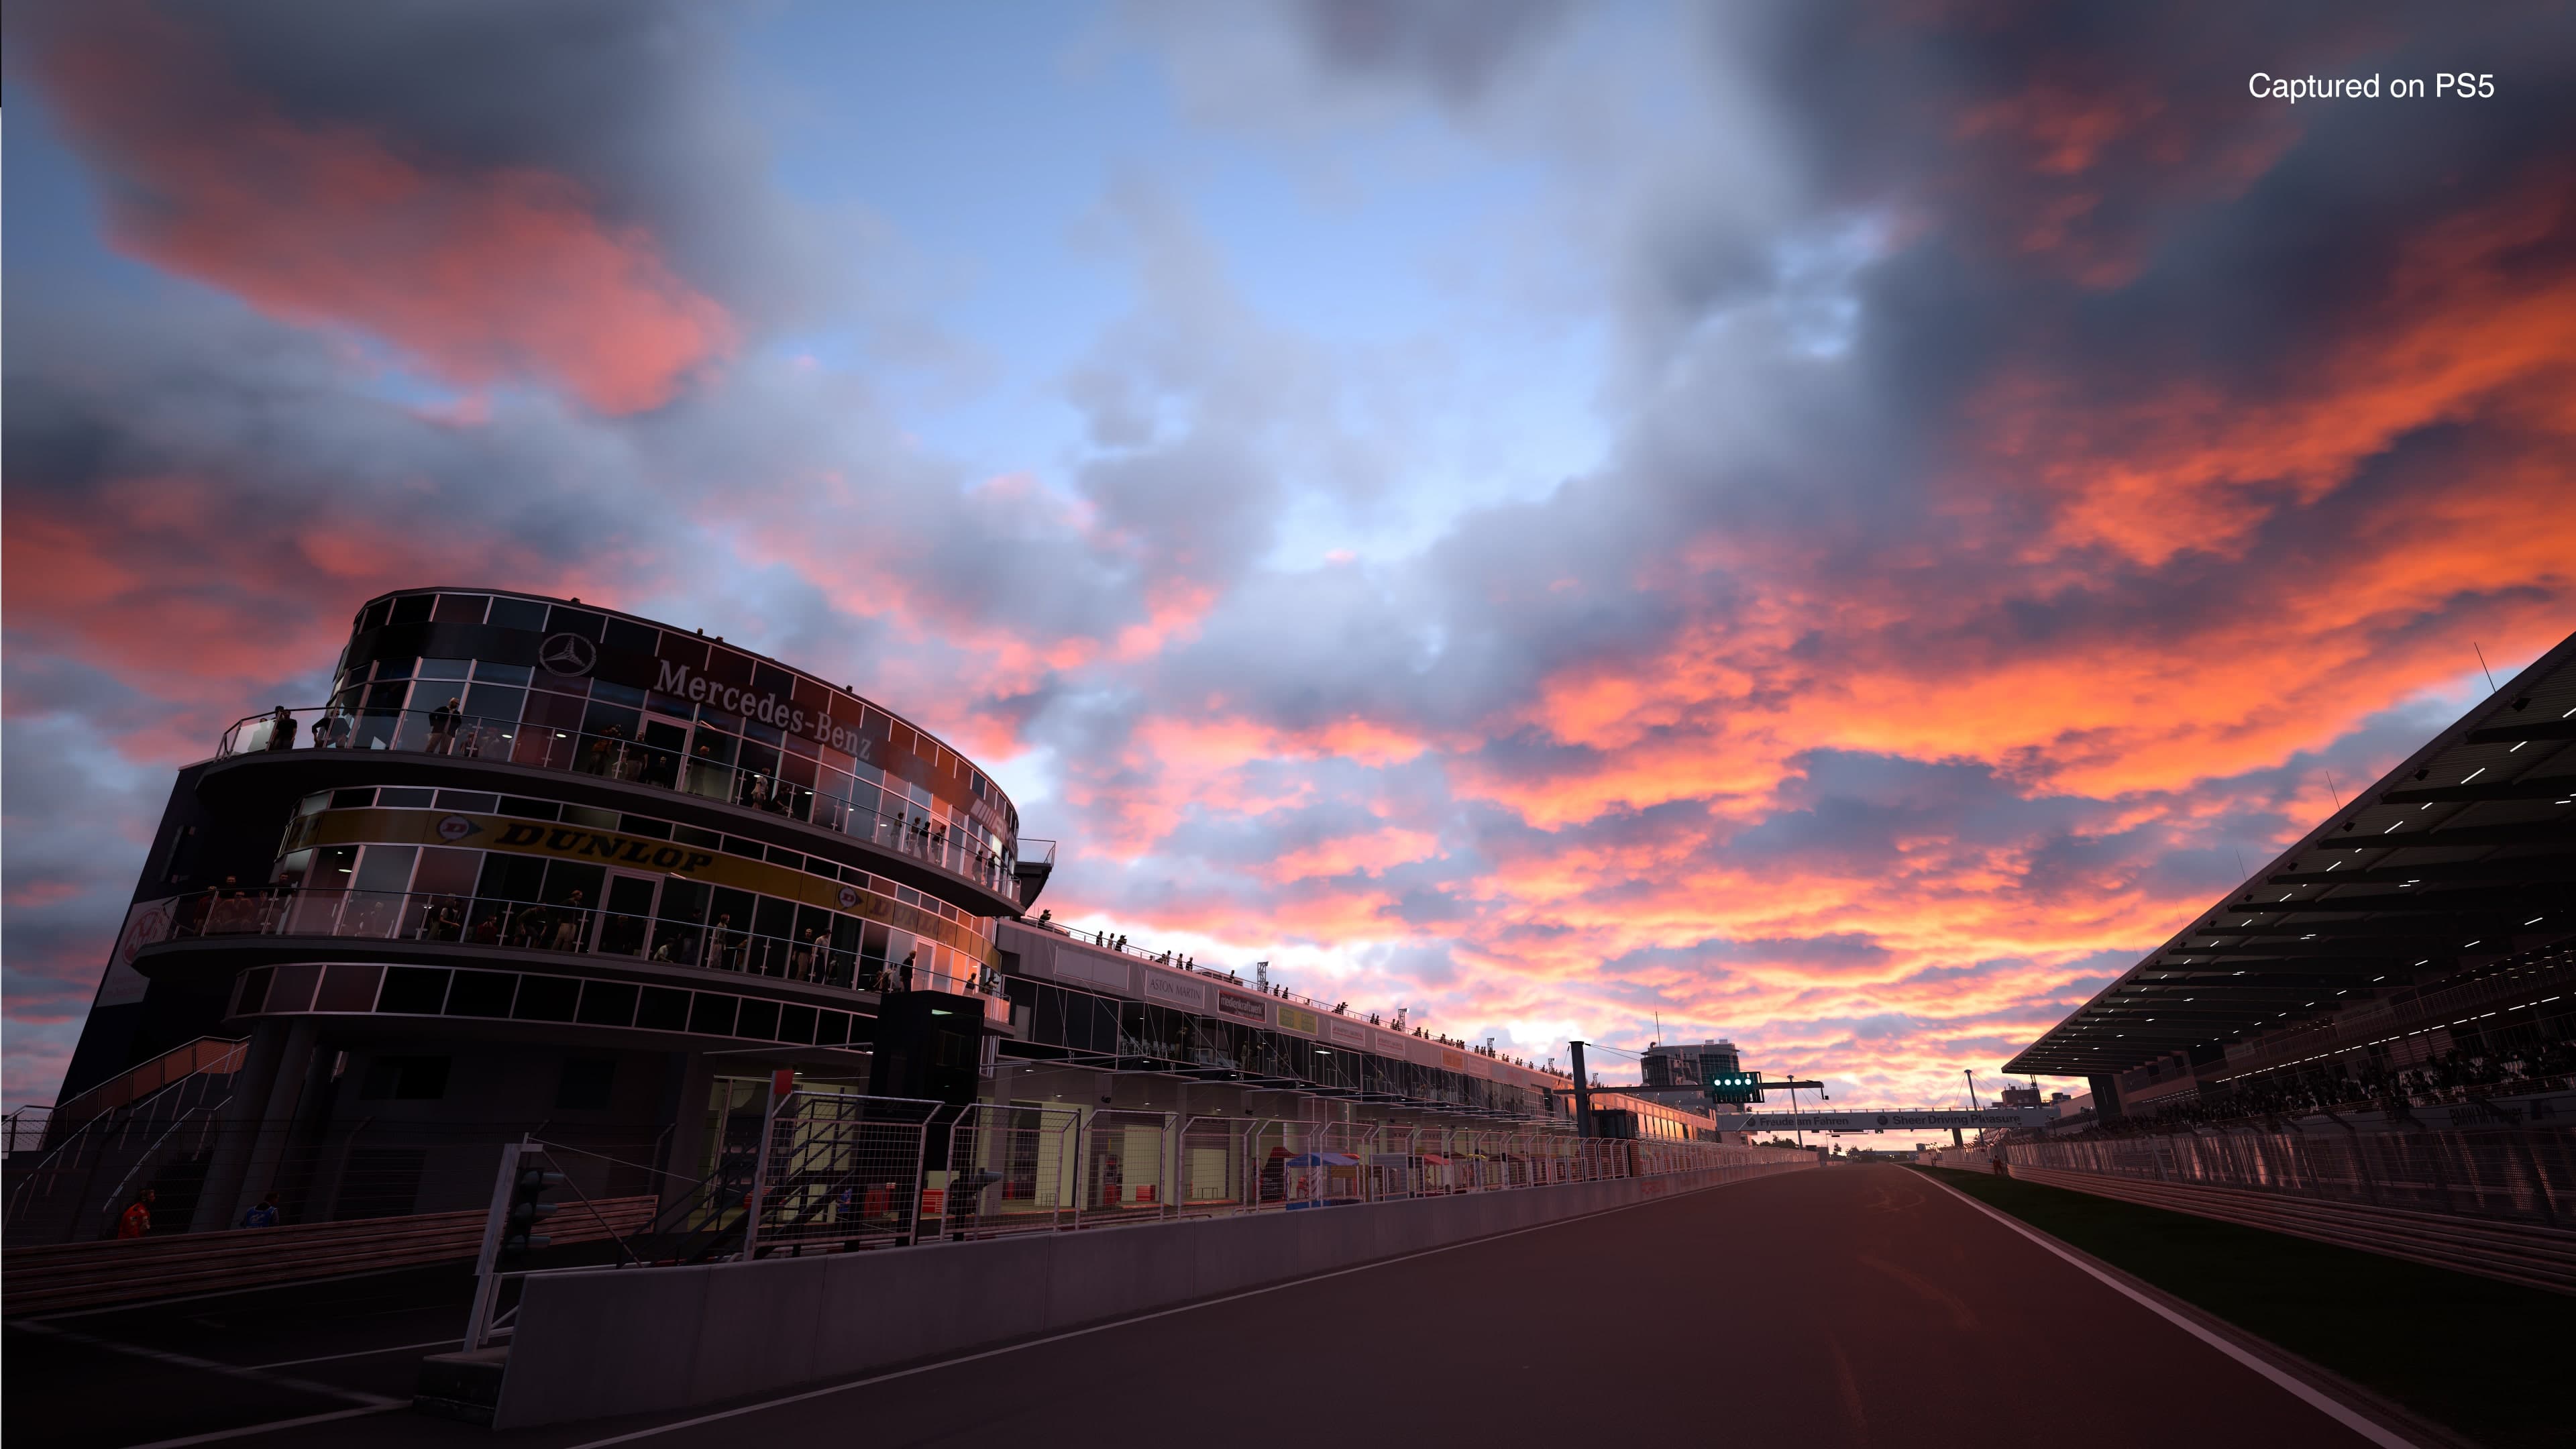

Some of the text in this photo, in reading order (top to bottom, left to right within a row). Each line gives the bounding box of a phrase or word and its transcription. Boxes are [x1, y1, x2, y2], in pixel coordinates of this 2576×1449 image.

[653, 659, 873, 761] Mercedes-Benz
[494, 823, 712, 872] DUNLOP
[1150, 979, 1201, 1000] ASTON MARTIN
[1760, 1117, 1794, 1126] Freude
[1813, 1117, 1849, 1126] Fahren
[1893, 1114, 2021, 1125] Sheer Driving Pleasure
